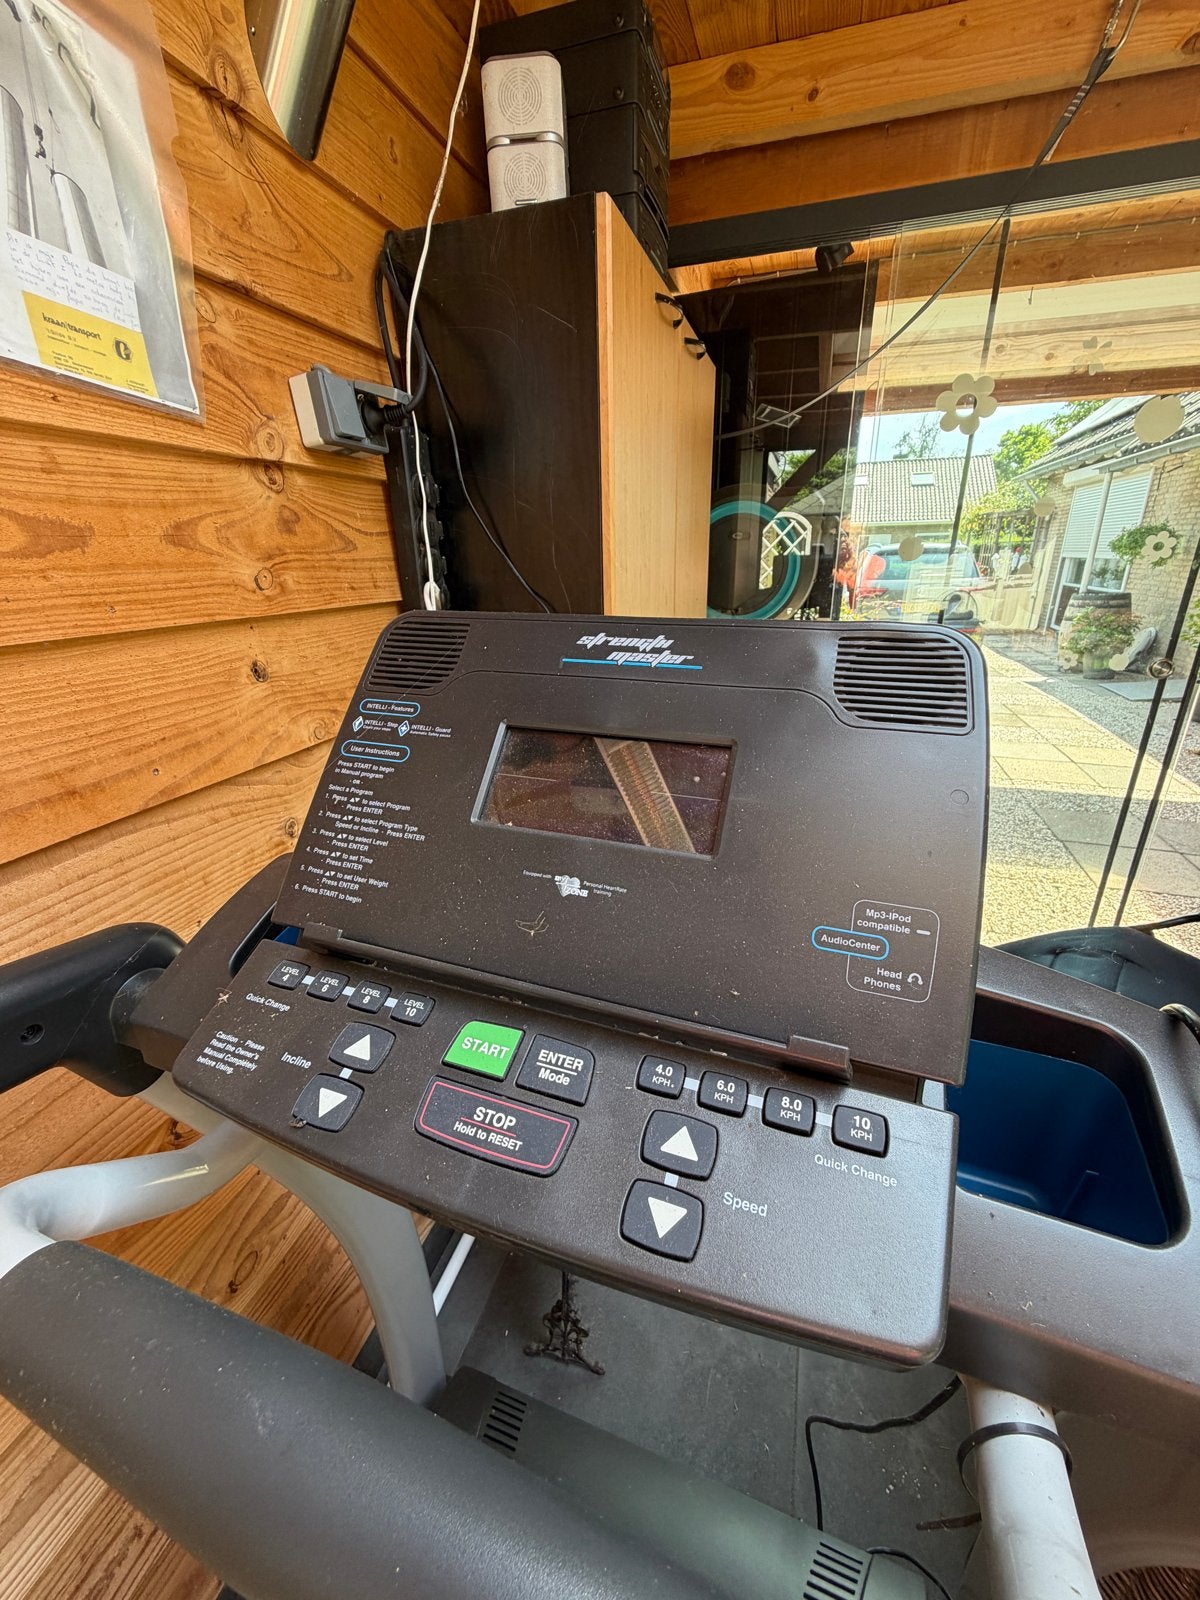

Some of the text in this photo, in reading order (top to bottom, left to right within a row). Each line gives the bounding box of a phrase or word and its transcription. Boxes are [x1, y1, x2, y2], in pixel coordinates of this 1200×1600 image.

[576, 632, 674, 652] strength
[606, 650, 694, 667] master
[391, 704, 415, 712] Features
[387, 721, 399, 729] Step
[411, 724, 431, 732] INTELLI
[350, 745, 400, 757] User Instructions
[338, 760, 352, 768] Press
[353, 762, 372, 770] START
[379, 765, 395, 774] begin
[341, 768, 360, 776] Manual
[350, 787, 373, 796] Program
[362, 806, 383, 815] ENTER
[386, 801, 411, 811] Program
[325, 811, 341, 819] Press
[378, 820, 403, 830] Program
[404, 824, 418, 832] Type
[319, 829, 335, 837] Press
[355, 836, 373, 844] select
[372, 838, 389, 847] Level
[335, 821, 352, 829] Speed
[360, 826, 379, 834] Incline
[386, 830, 403, 838] Press
[403, 832, 425, 841] ENTER
[331, 840, 347, 848] Press
[348, 843, 369, 851] ENTER
[313, 847, 329, 856] Press
[359, 856, 373, 864] Time
[325, 858, 341, 866] Press
[342, 861, 363, 870] ENTER
[307, 866, 324, 874] Press
[353, 875, 368, 883] User
[368, 878, 389, 888] Weight
[321, 877, 337, 886] Press
[338, 881, 359, 891] ENTER
[583, 881, 603, 889] Personal
[302, 885, 318, 894] Press
[319, 888, 338, 898] START
[345, 895, 362, 904] begin
[857, 919, 911, 934] compatible
[820, 934, 880, 952] AudioCenter
[281, 965, 300, 976] LEVEL
[877, 967, 902, 980] Head
[283, 974, 287, 982] 4
[320, 976, 339, 987] LEVEL
[863, 976, 902, 991] Phones
[321, 984, 328, 993] 6
[361, 986, 381, 998] LEVEL
[246, 993, 291, 1012] Quick Change
[363, 995, 369, 1004] 8
[403, 998, 425, 1010] LEVEL
[405, 1007, 416, 1017] 10
[216, 1031, 239, 1043] Caution
[244, 1039, 265, 1052] Please
[461, 1036, 510, 1059] START
[209, 1038, 260, 1060] Read the Owner's
[196, 1055, 217, 1067] before
[203, 1047, 258, 1072] Manual Completely
[281, 1051, 312, 1069] Incline
[538, 1049, 584, 1071] ENTER
[538, 1067, 570, 1086] Mode
[655, 1063, 673, 1077] 4.0
[652, 1075, 671, 1087] KPH
[716, 1079, 735, 1093] 6.0
[713, 1091, 734, 1104] KPH
[780, 1096, 803, 1112] 8.0
[473, 1106, 517, 1130] STOP
[780, 1108, 801, 1122] KPH
[853, 1115, 872, 1130] 10
[453, 1121, 523, 1151] Hold to RESET
[850, 1127, 873, 1142] KPH
[814, 1154, 898, 1188] Quick Change
[723, 1191, 768, 1218] Speed
